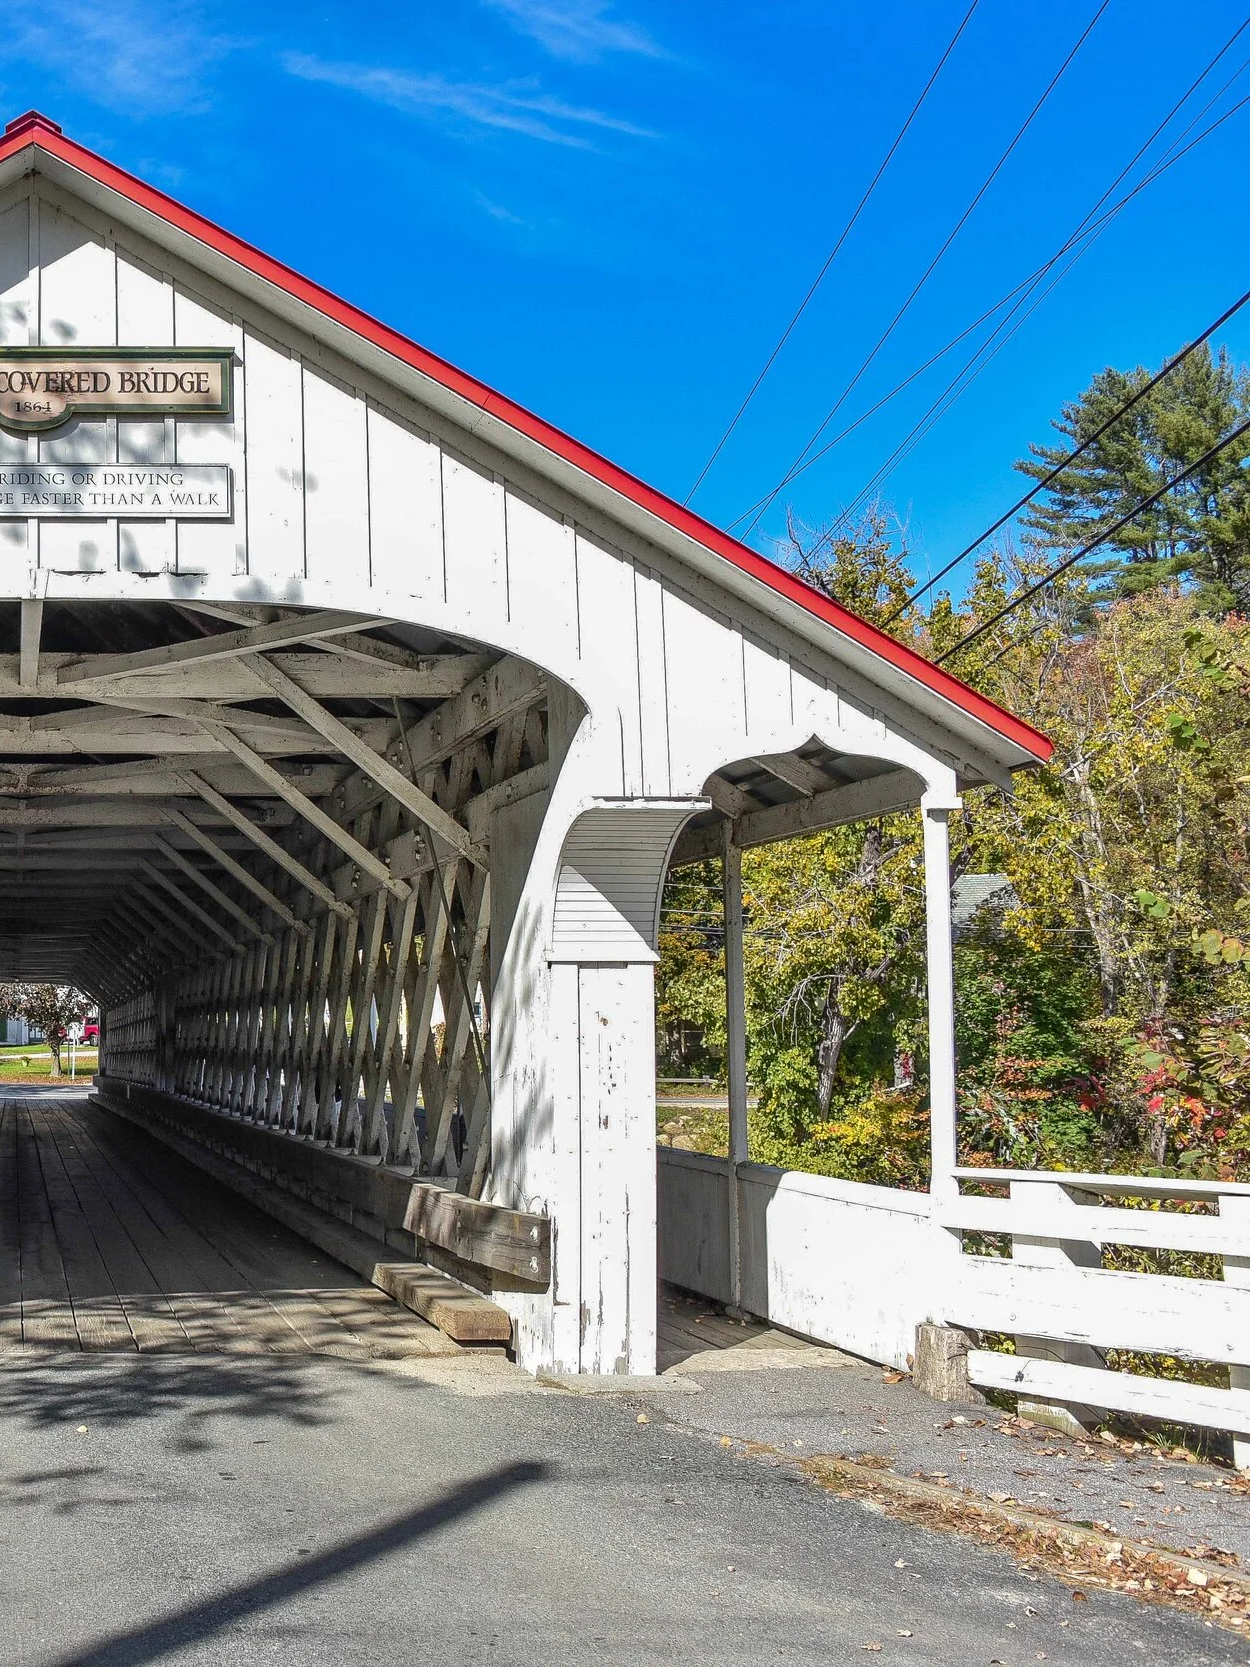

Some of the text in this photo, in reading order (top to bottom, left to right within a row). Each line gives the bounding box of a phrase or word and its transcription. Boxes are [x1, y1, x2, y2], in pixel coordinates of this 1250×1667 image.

[118, 371, 211, 393] BRIDGE
[14, 401, 52, 413] 1864
[71, 472, 97, 486] OR
[103, 472, 184, 486] DRIVING
[21, 492, 84, 505] FASTER
[89, 492, 145, 505] THAN
[150, 493, 162, 505] A
[170, 493, 220, 506] WALK
